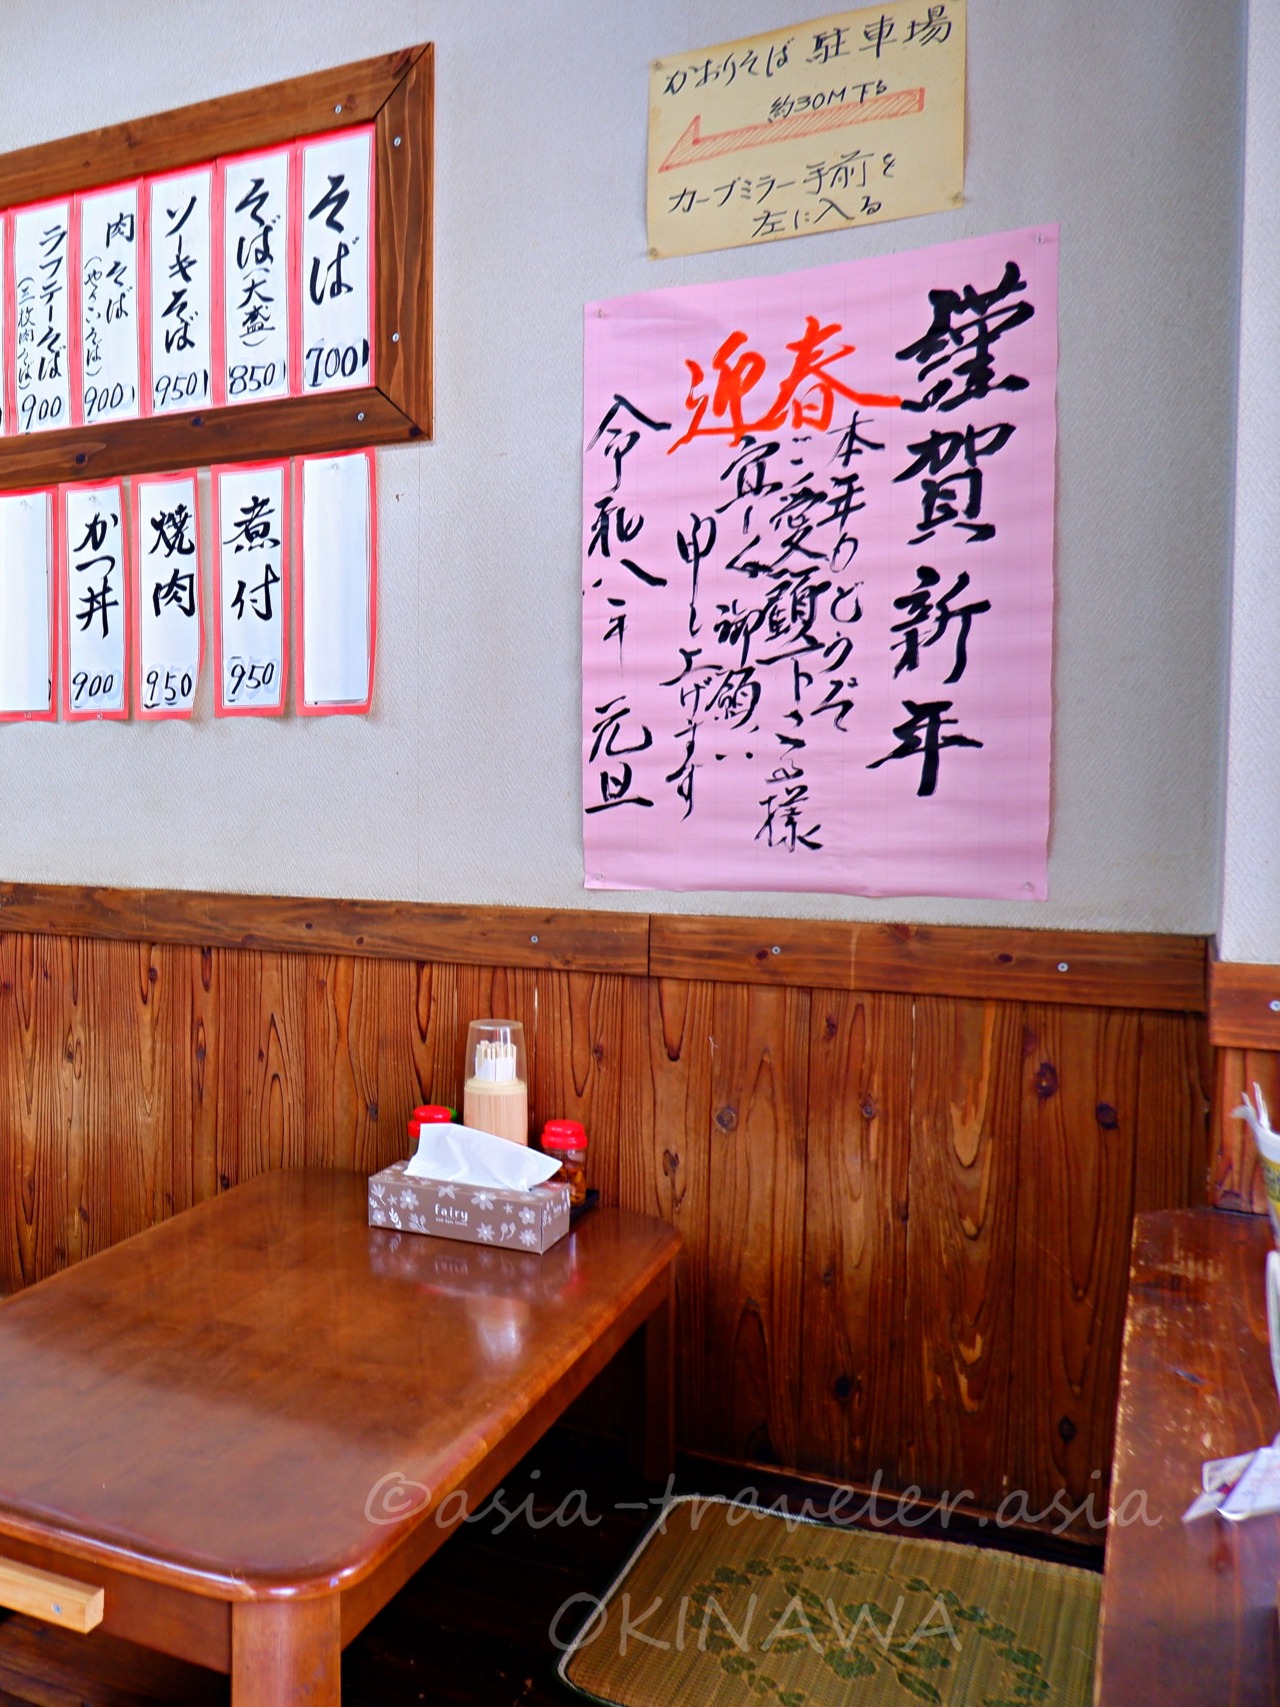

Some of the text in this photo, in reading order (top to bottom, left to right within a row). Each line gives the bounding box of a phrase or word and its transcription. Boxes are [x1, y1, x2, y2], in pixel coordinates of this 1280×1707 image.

[106, 212, 134, 324] 肉そば
[308, 174, 359, 305] そば
[752, 197, 881, 237] 左に入る
[37, 225, 68, 381] ラフテーそば
[161, 195, 198, 354] ソーキそば
[22, 393, 62, 431] 900
[85, 383, 123, 417] 900
[668, 315, 903, 455] 迎春
[73, 512, 119, 639] かつ丼
[148, 503, 195, 617] 焼肉
[223, 496, 280, 621] 煮付
[866, 261, 1035, 797] 謹賀新年
[72, 672, 113, 701] 900
[147, 671, 195, 706] 950
[231, 662, 274, 695] 950
[435, 1203, 468, 1220] fairy
